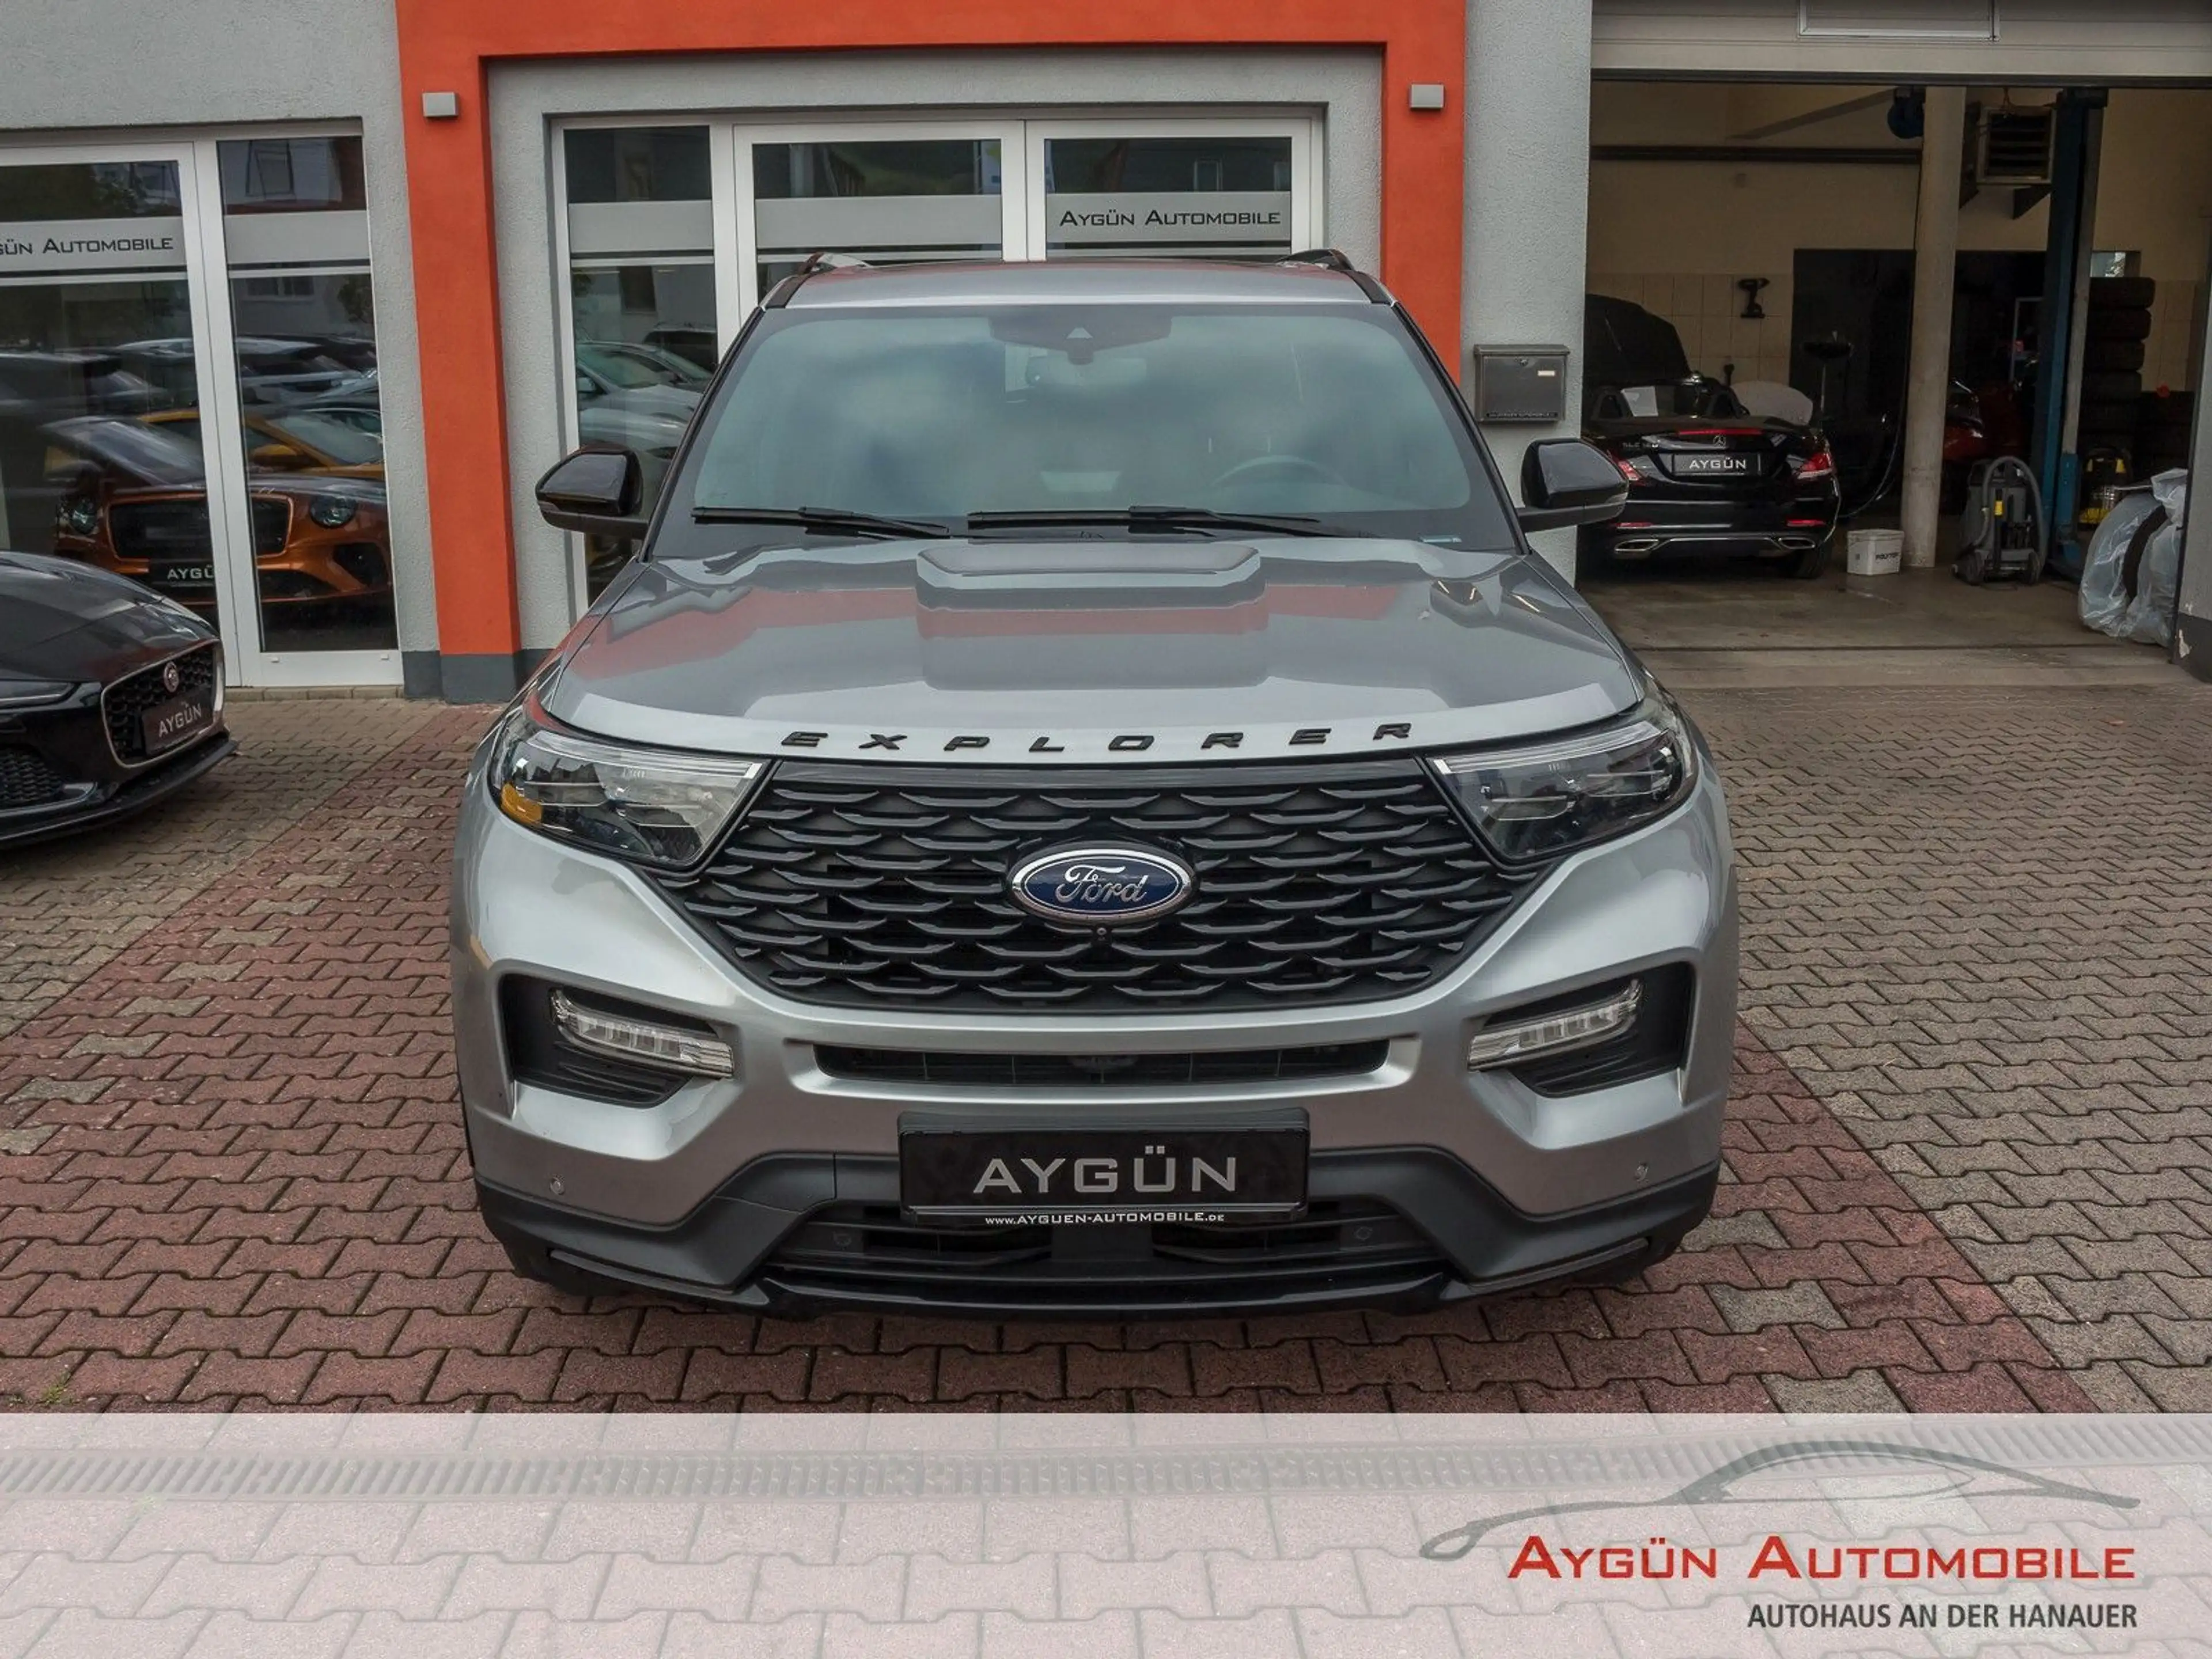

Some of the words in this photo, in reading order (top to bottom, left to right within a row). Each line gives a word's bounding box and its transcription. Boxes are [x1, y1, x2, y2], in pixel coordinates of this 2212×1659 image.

[1145, 209, 1282, 226] AUTOMOBILE
[42, 237, 174, 254] AUTOMOBILE
[1689, 457, 1747, 470] AYGÜN
[158, 701, 202, 738] AYGÜN
[781, 722, 1412, 752] EXPLORER
[1054, 863, 1149, 904] Ford
[973, 1145, 1237, 1194] AYGÜN
